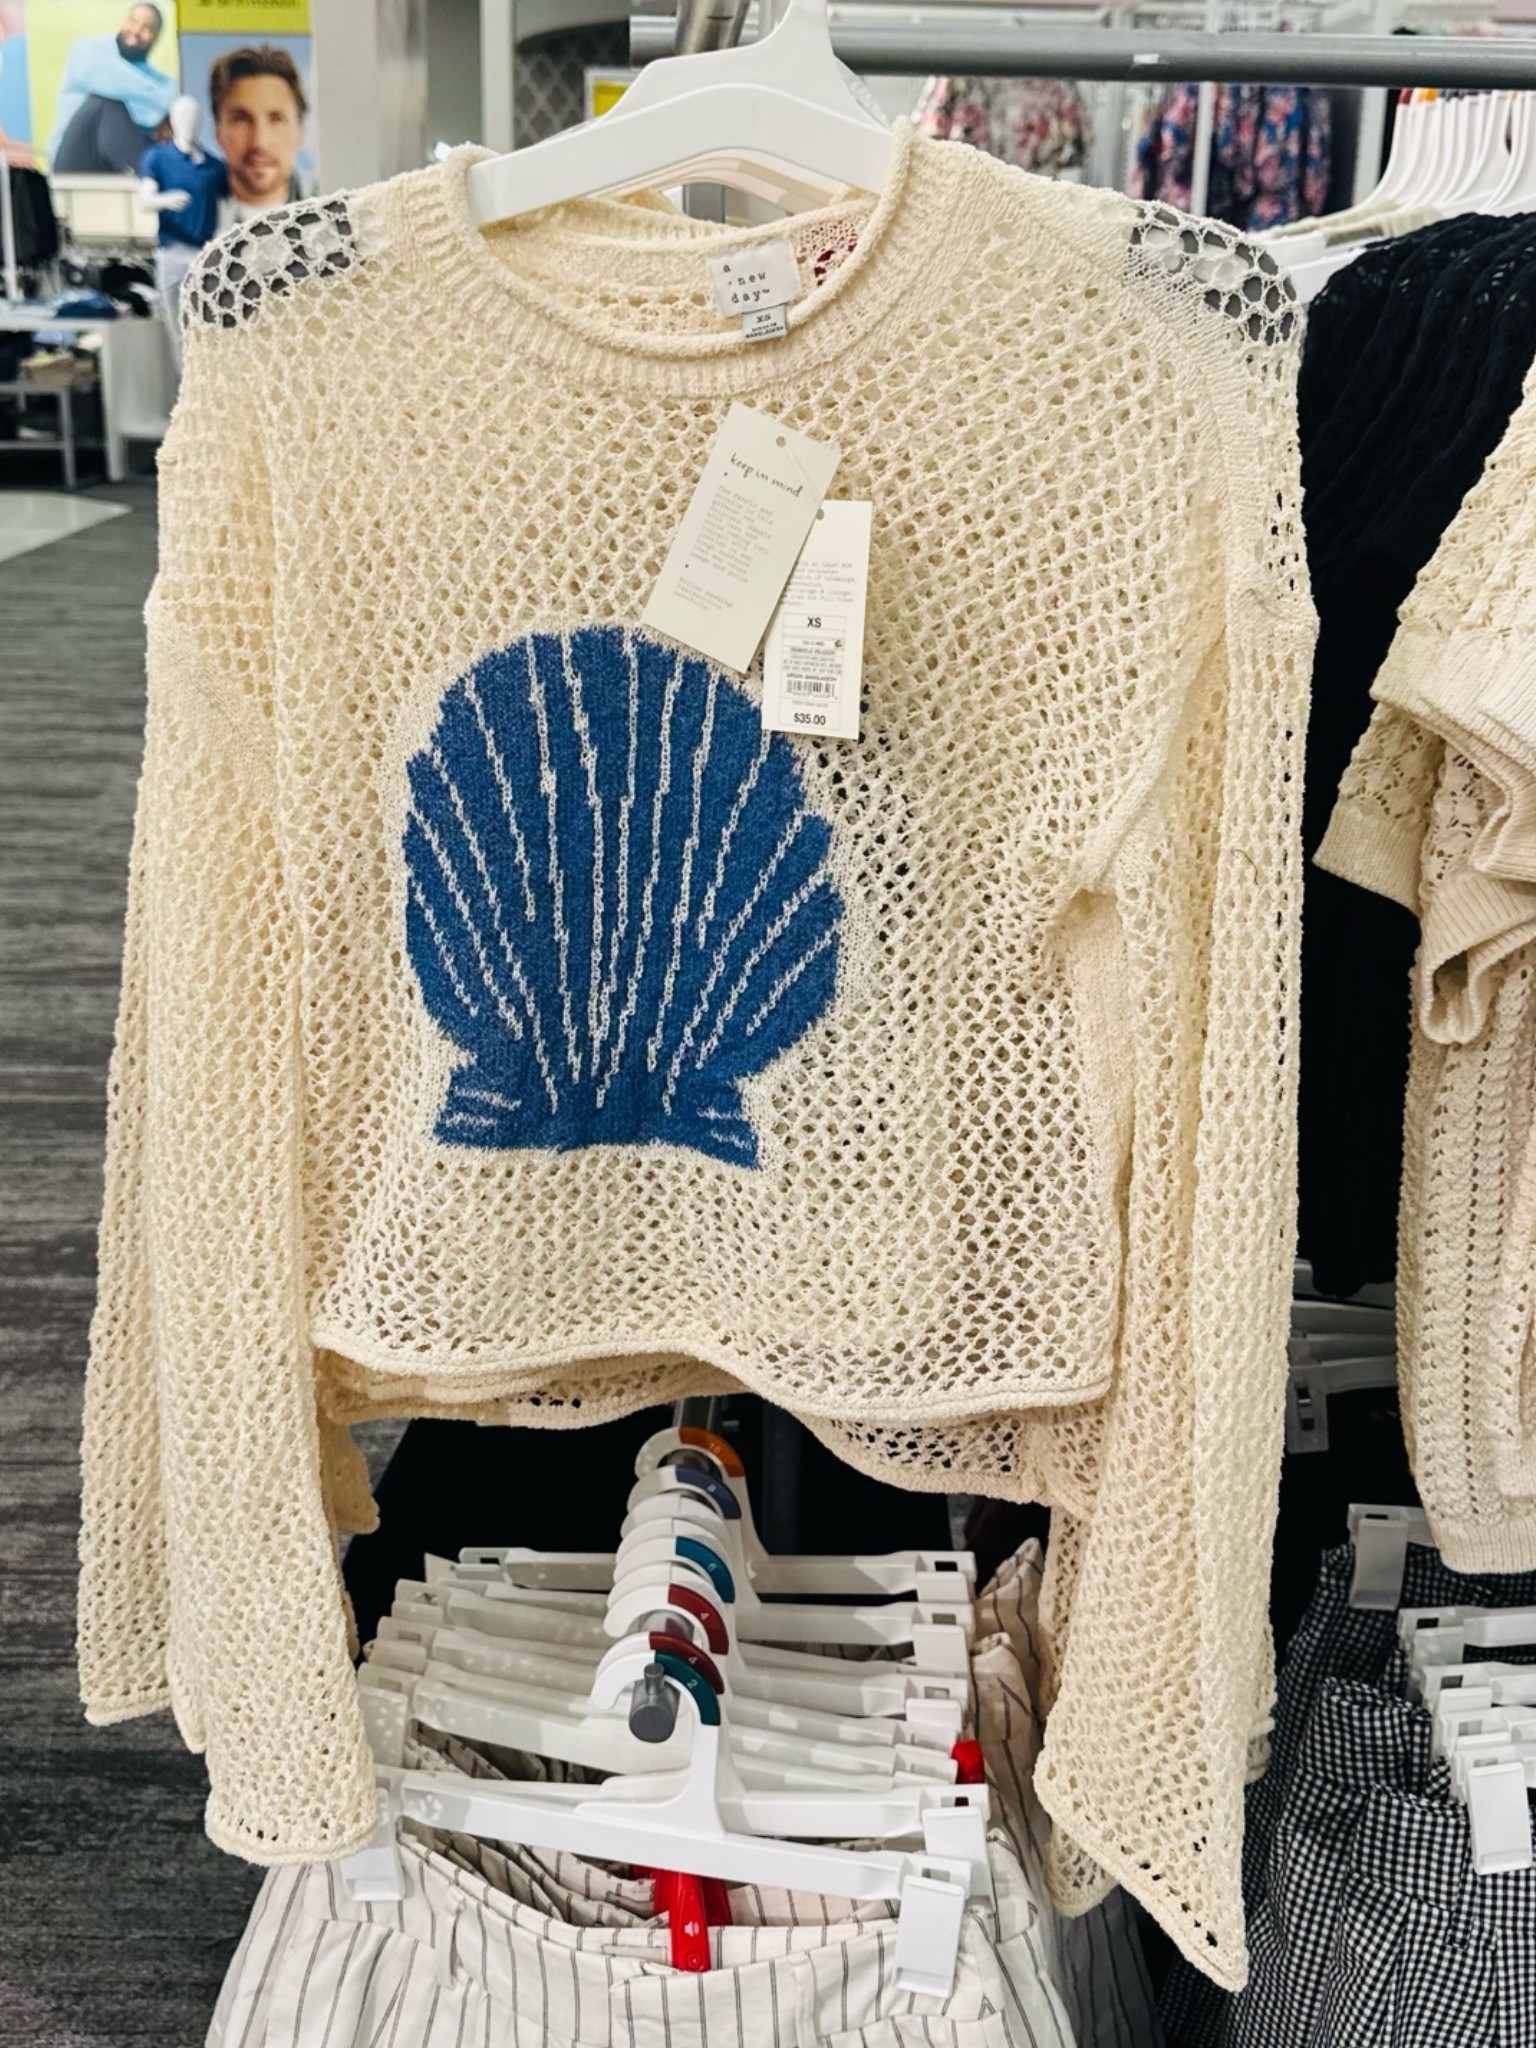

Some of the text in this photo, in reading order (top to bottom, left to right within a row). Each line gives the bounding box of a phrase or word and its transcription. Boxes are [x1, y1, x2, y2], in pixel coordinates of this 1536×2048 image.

[723, 264, 731, 273] a
[737, 272, 766, 286] new
[730, 452, 803, 498] keep in mind
[807, 617, 822, 628] XS
[793, 713, 826, 726] $35.00
[686, 1679, 698, 1690] 2
